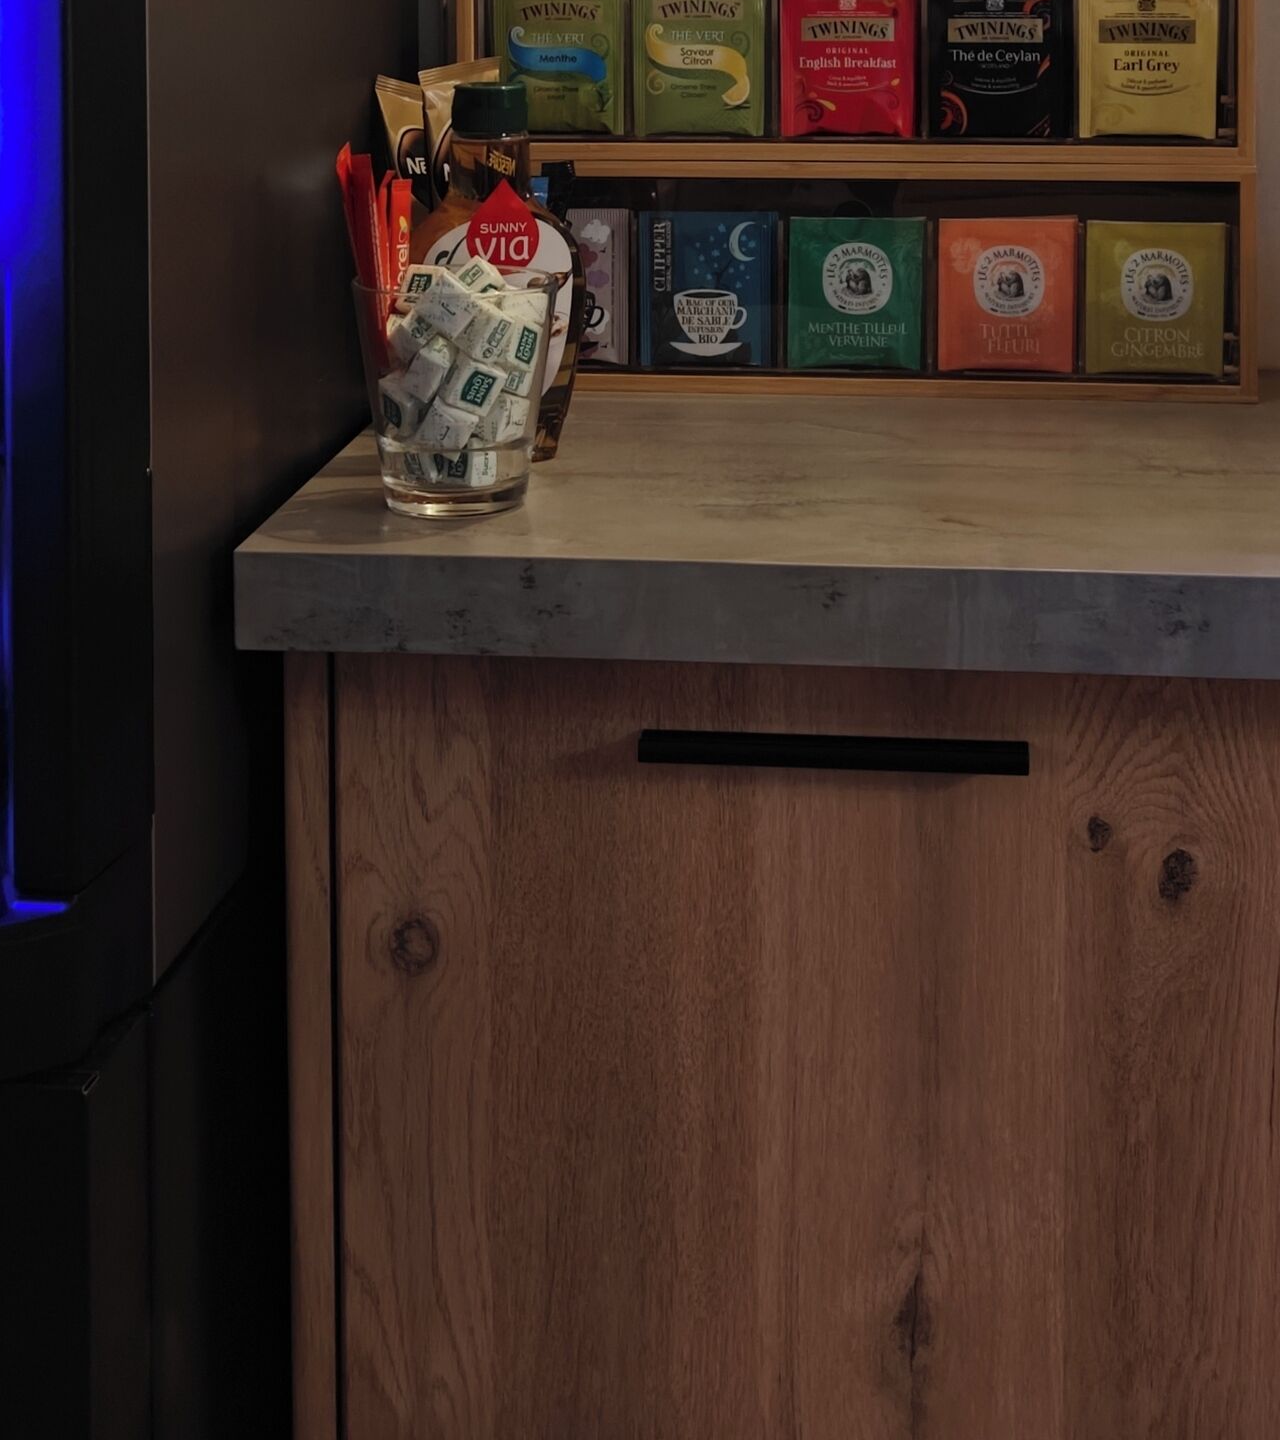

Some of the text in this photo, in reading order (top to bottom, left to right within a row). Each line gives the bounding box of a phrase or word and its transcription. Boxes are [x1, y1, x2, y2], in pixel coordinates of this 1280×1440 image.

[520, 2, 598, 21] TWININGS
[658, 0, 737, 18] TWININGS
[695, 30, 725, 42] VERT
[807, 20, 889, 39] TWININGS
[955, 21, 1037, 40] TWININGS
[1106, 22, 1190, 41] TWININGS
[556, 32, 586, 44] VERT
[539, 54, 578, 64] Menthe
[680, 47, 715, 57] Saveur
[825, 47, 869, 55] ORIGINAL
[949, 48, 1041, 64] Thé de Ceylan
[1124, 49, 1170, 57] ORIGINAL
[681, 56, 713, 66] Citron
[799, 56, 897, 71] English Breakfast
[1113, 58, 1180, 74] Earl Grey
[479, 222, 528, 234] SUNNY
[474, 235, 530, 261] via
[653, 222, 666, 292] CLIPPER
[826, 246, 889, 280] LES 2 MARMOTTES
[993, 248, 1041, 282] MARMOTTES
[1133, 258, 1140, 268] 2
[1140, 250, 1190, 286] MARMOTTES
[677, 306, 736, 316] MARCHAND
[686, 299, 703, 307] BAG
[705, 299, 717, 307] OF
[681, 316, 732, 326] DE SABLE
[807, 322, 861, 335] MENTHE
[698, 334, 718, 344] BIO
[828, 335, 889, 348] VERVEINE
[1124, 327, 1191, 343] CITRON
[1110, 341, 1205, 359] GINGEMBRE
[466, 374, 486, 400] LOUIS
[475, 376, 493, 404] SAINT
